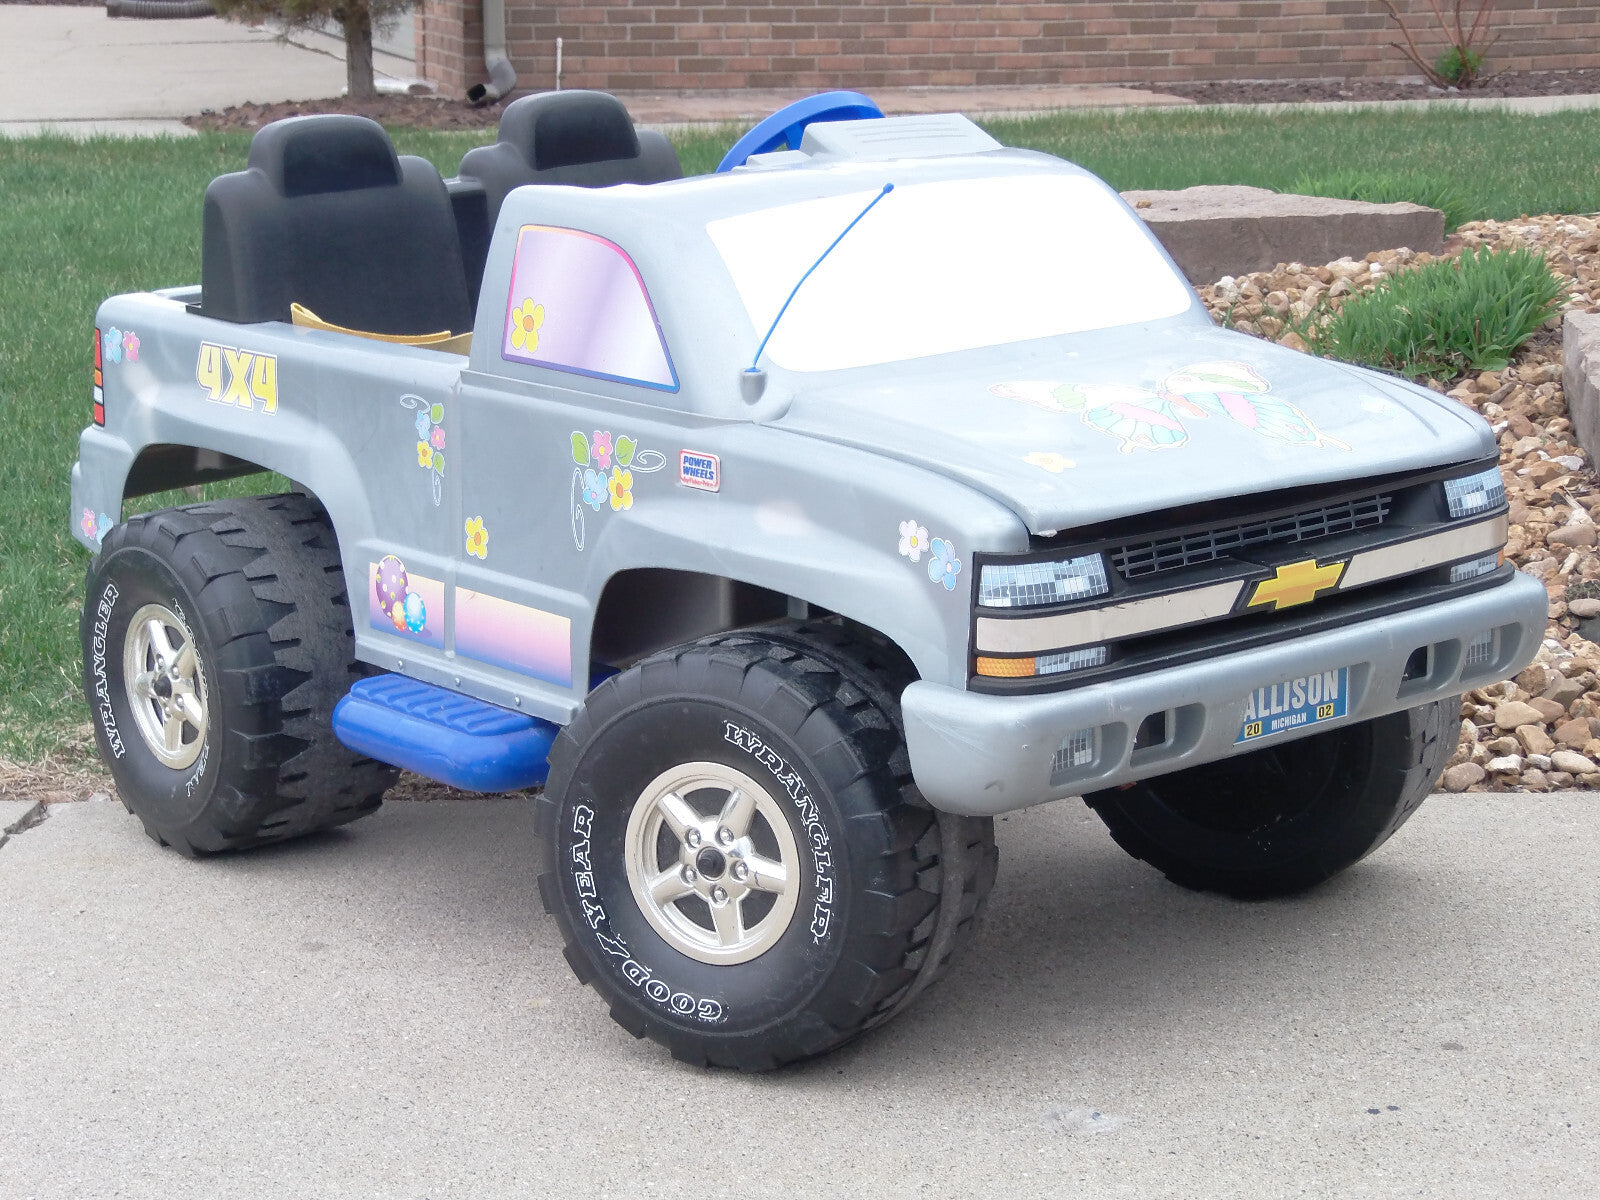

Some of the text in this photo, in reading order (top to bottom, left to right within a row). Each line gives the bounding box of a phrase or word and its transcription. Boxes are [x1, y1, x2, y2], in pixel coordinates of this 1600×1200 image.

[196, 340, 279, 416] 4X4
[682, 465, 715, 481] WHEELS
[683, 455, 713, 470] POWER
[92, 583, 126, 759] WRANGLER
[1243, 669, 1339, 721] ALLISON
[1246, 704, 1332, 736] 20 MICHIGAN 02
[724, 722, 834, 940] WRANGLER
